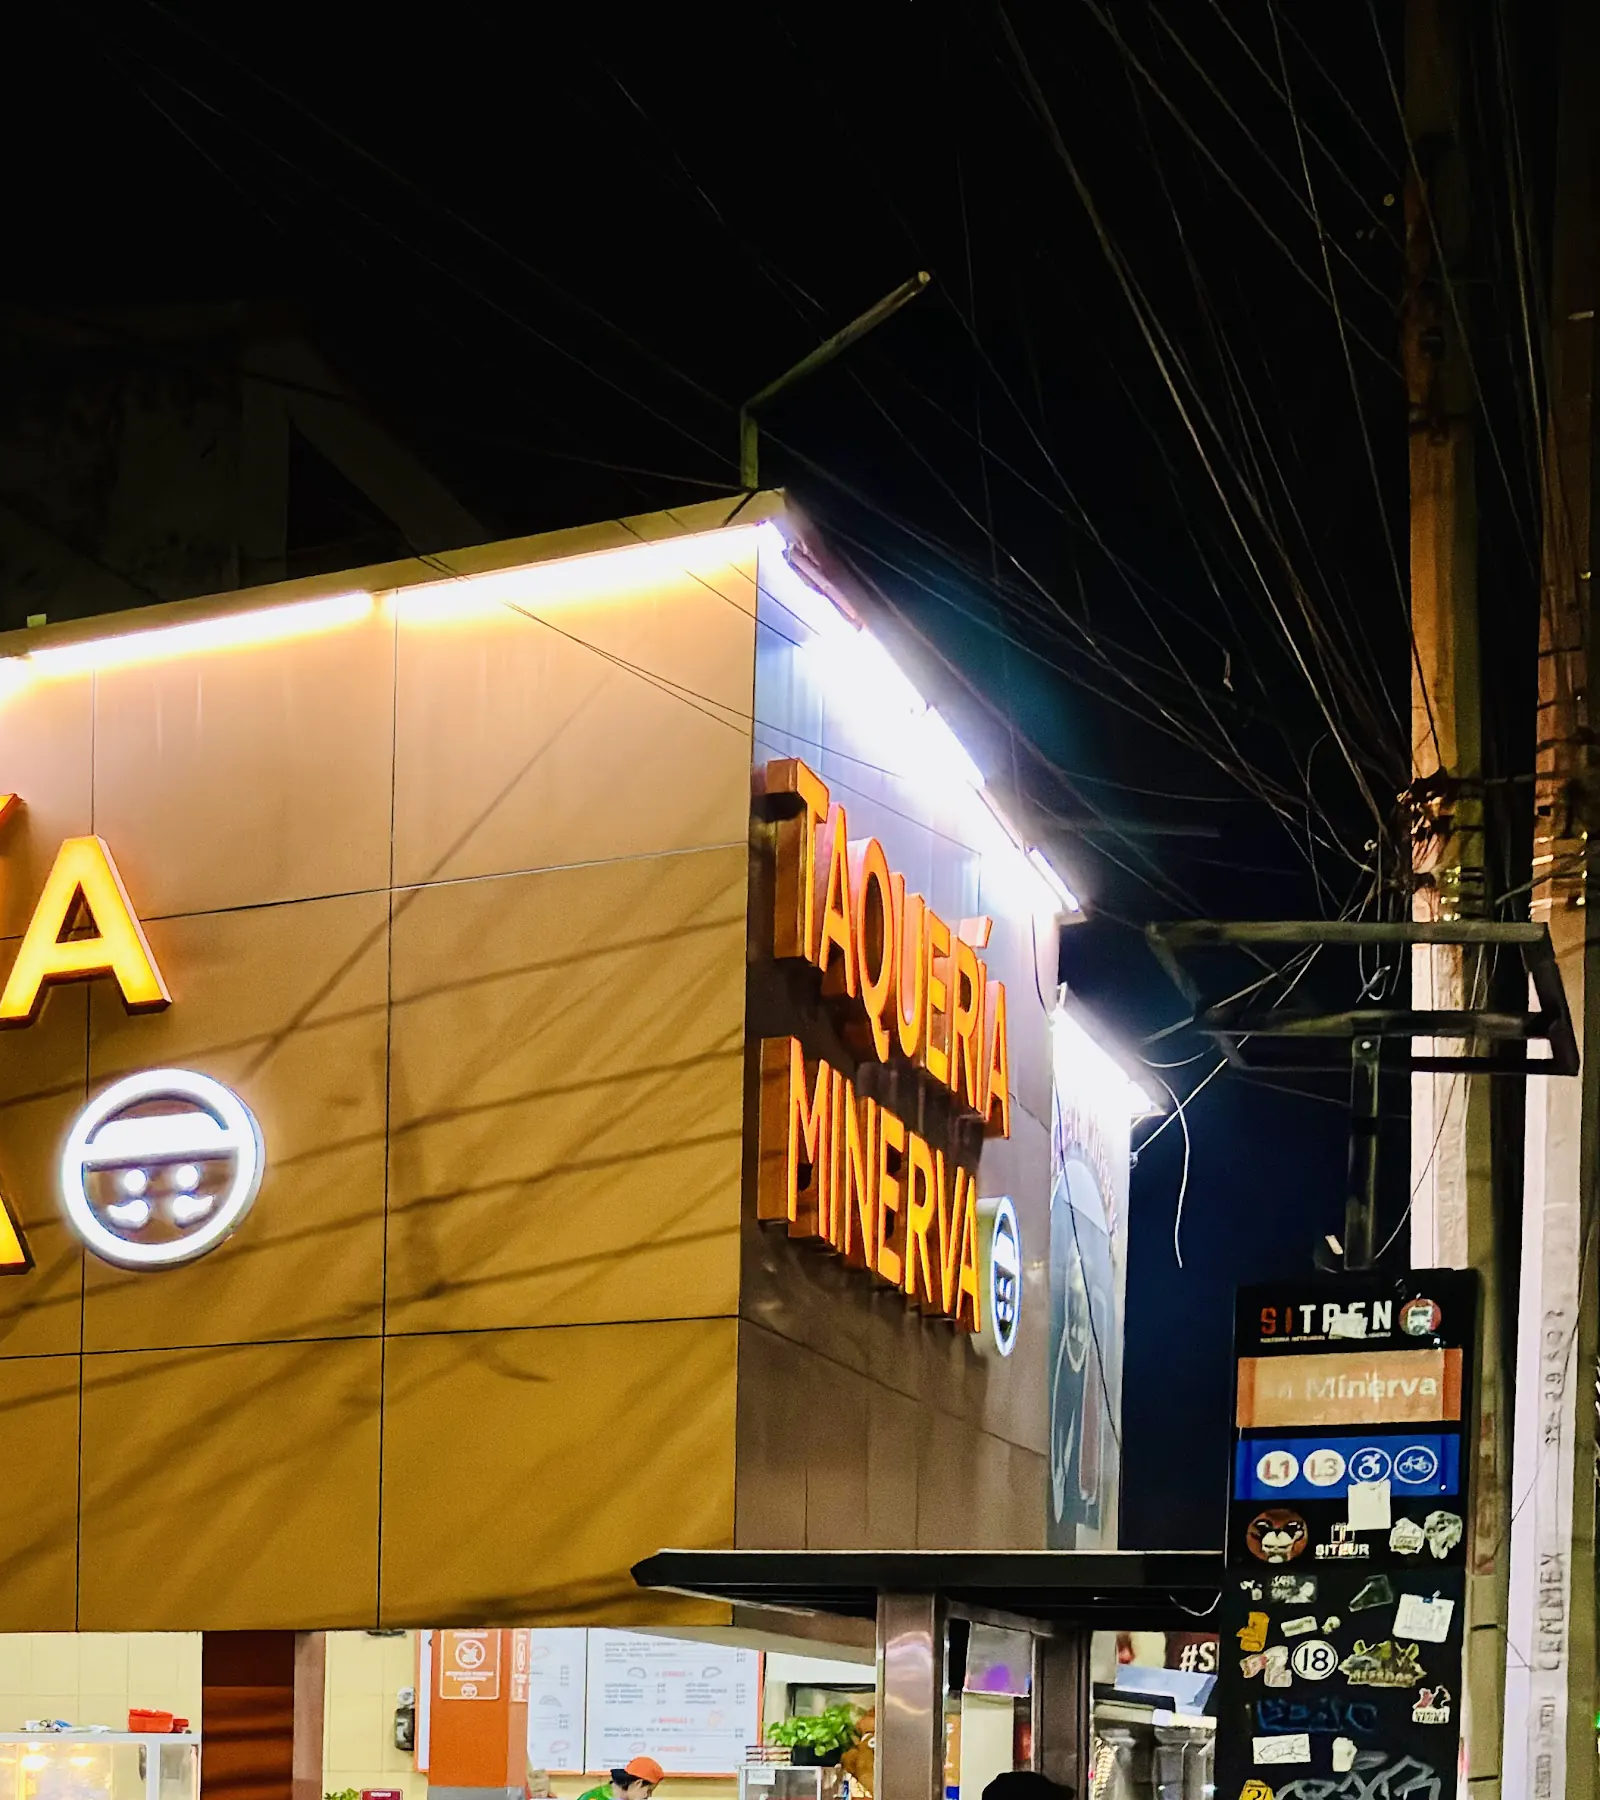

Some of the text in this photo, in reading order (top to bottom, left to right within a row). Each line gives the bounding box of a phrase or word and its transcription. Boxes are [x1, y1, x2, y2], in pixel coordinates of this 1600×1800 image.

[767, 757, 1010, 1139] TAQUERÍA
[758, 1036, 982, 1333] MINERVA
[1306, 1373, 1437, 1401] Minerva
[1263, 1458, 1339, 1480] L1 L3
[1302, 1648, 1329, 1672] 18
